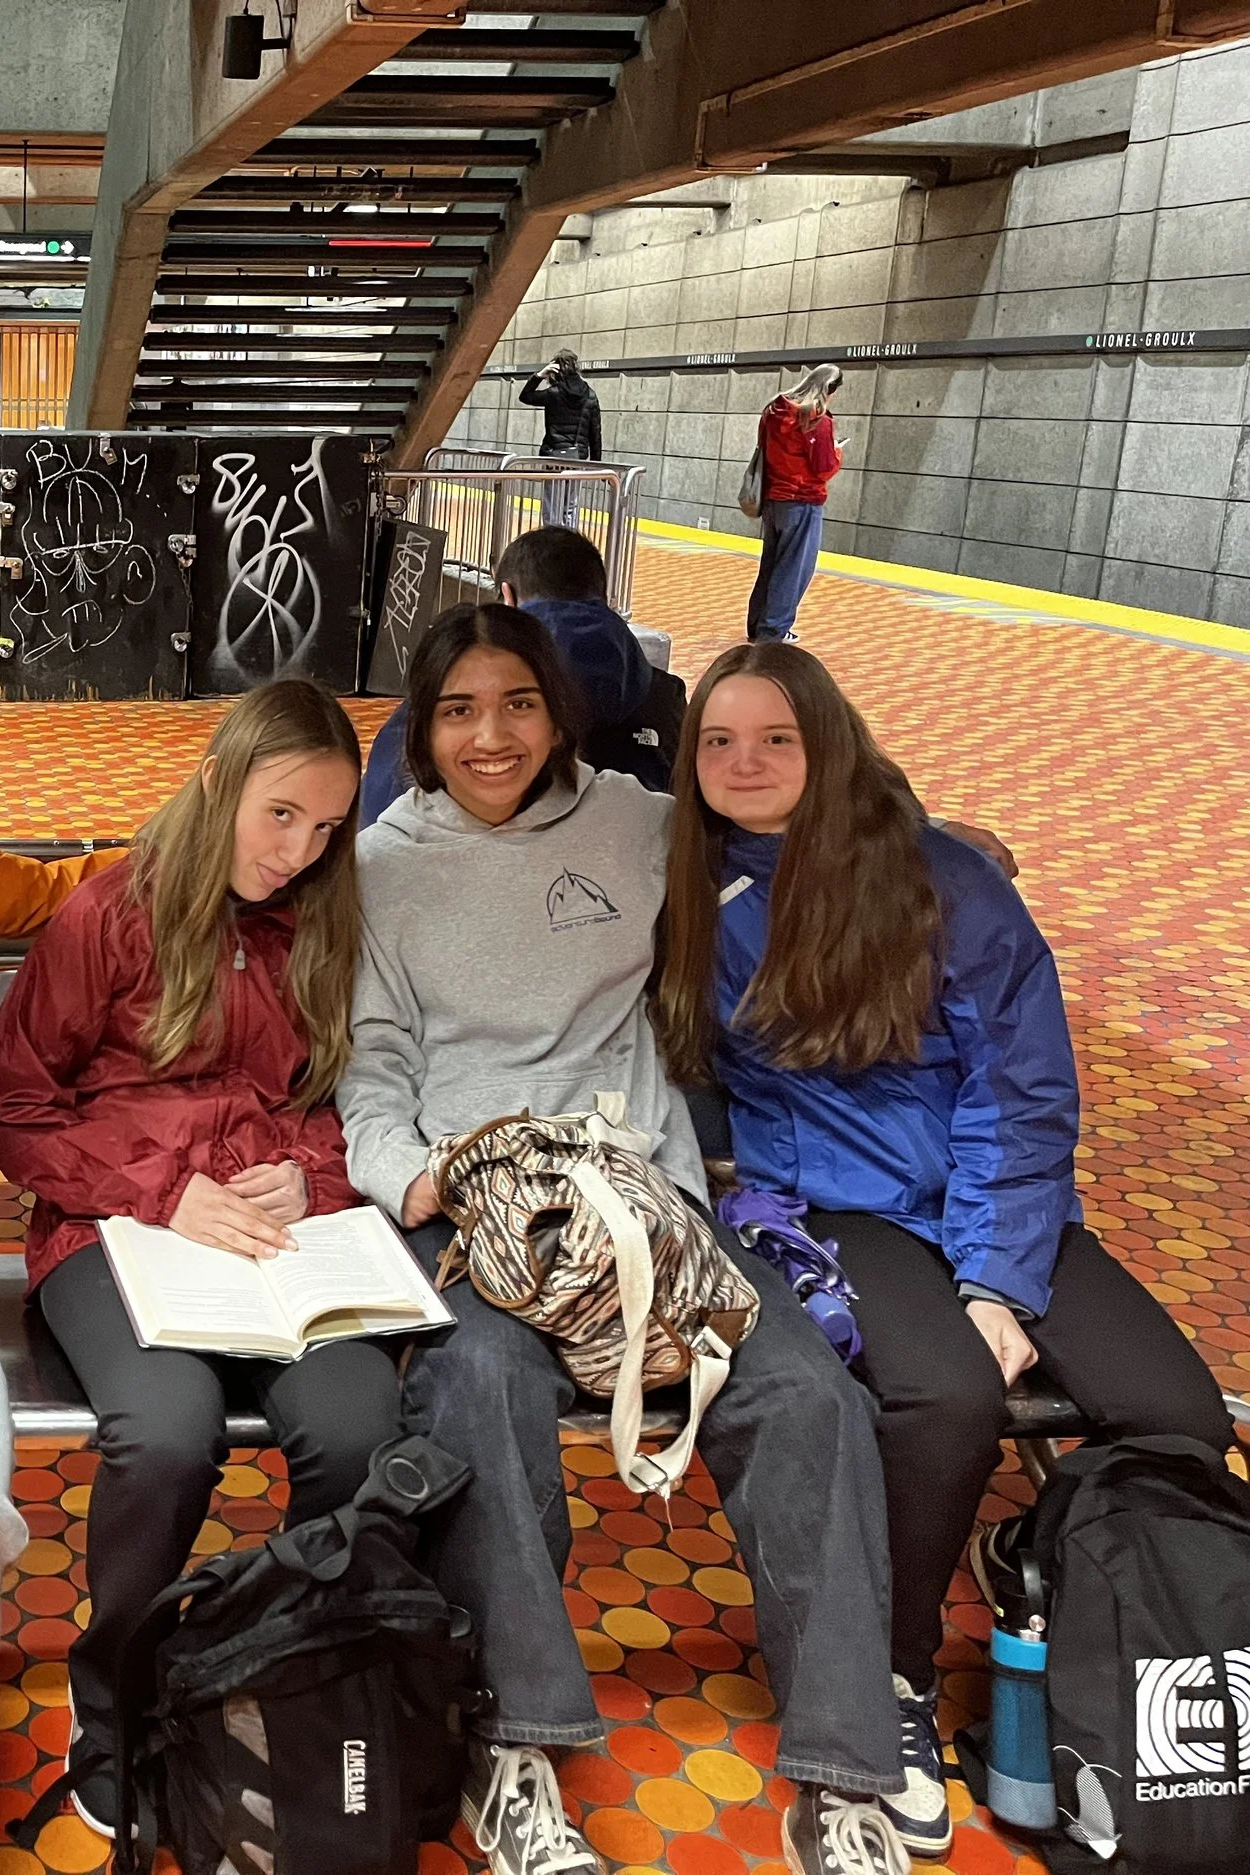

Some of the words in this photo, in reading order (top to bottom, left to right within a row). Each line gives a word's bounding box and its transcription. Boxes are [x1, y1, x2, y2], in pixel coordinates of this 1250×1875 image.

[853, 343, 917, 357] LIONEL-GROULX
[1095, 331, 1196, 348] LIONEL-GROULX
[343, 1740, 367, 1814] CAMELBAK
[1135, 1777, 1237, 1802] Education
